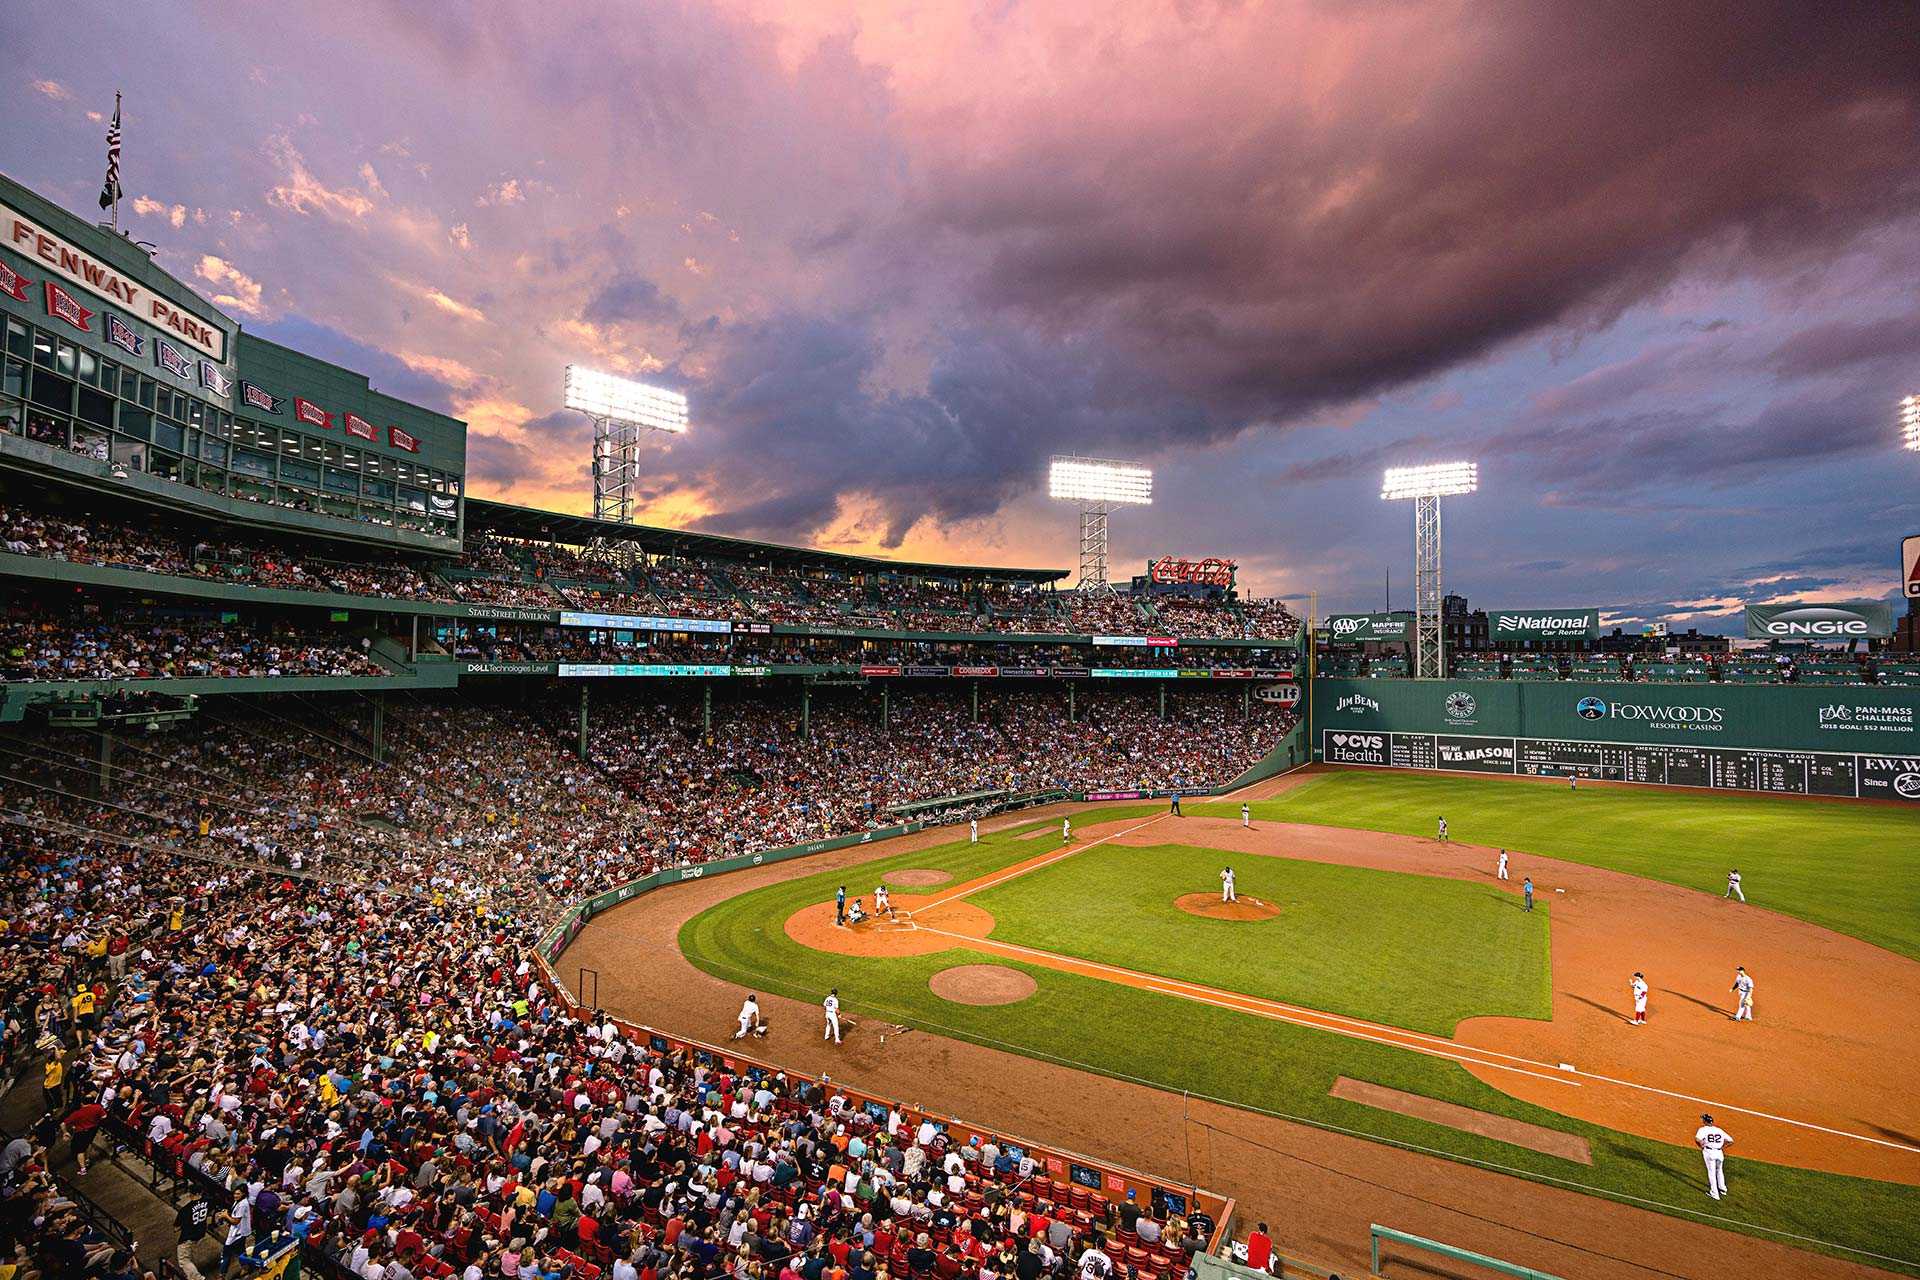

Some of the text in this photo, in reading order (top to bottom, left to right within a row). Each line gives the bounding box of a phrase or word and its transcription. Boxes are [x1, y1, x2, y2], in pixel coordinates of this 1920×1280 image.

[13, 220, 213, 349] FENWAY PARK
[468, 607, 551, 621] STATE STREET PAVILION
[1335, 617, 1356, 634] AAA
[531, 664, 548, 672] Level
[1258, 686, 1298, 699] Gulf
[1336, 694, 1379, 712] JIM BEAM
[1610, 702, 1723, 723] FOXWOODS
[1855, 706, 1913, 715] PAN-MASS
[1855, 714, 1913, 722] CHALLENGE
[1650, 722, 1723, 731] RESORT CASINO
[1348, 734, 1384, 749] CVS
[1333, 747, 1384, 763] Health
[1864, 779, 1888, 787] Since
